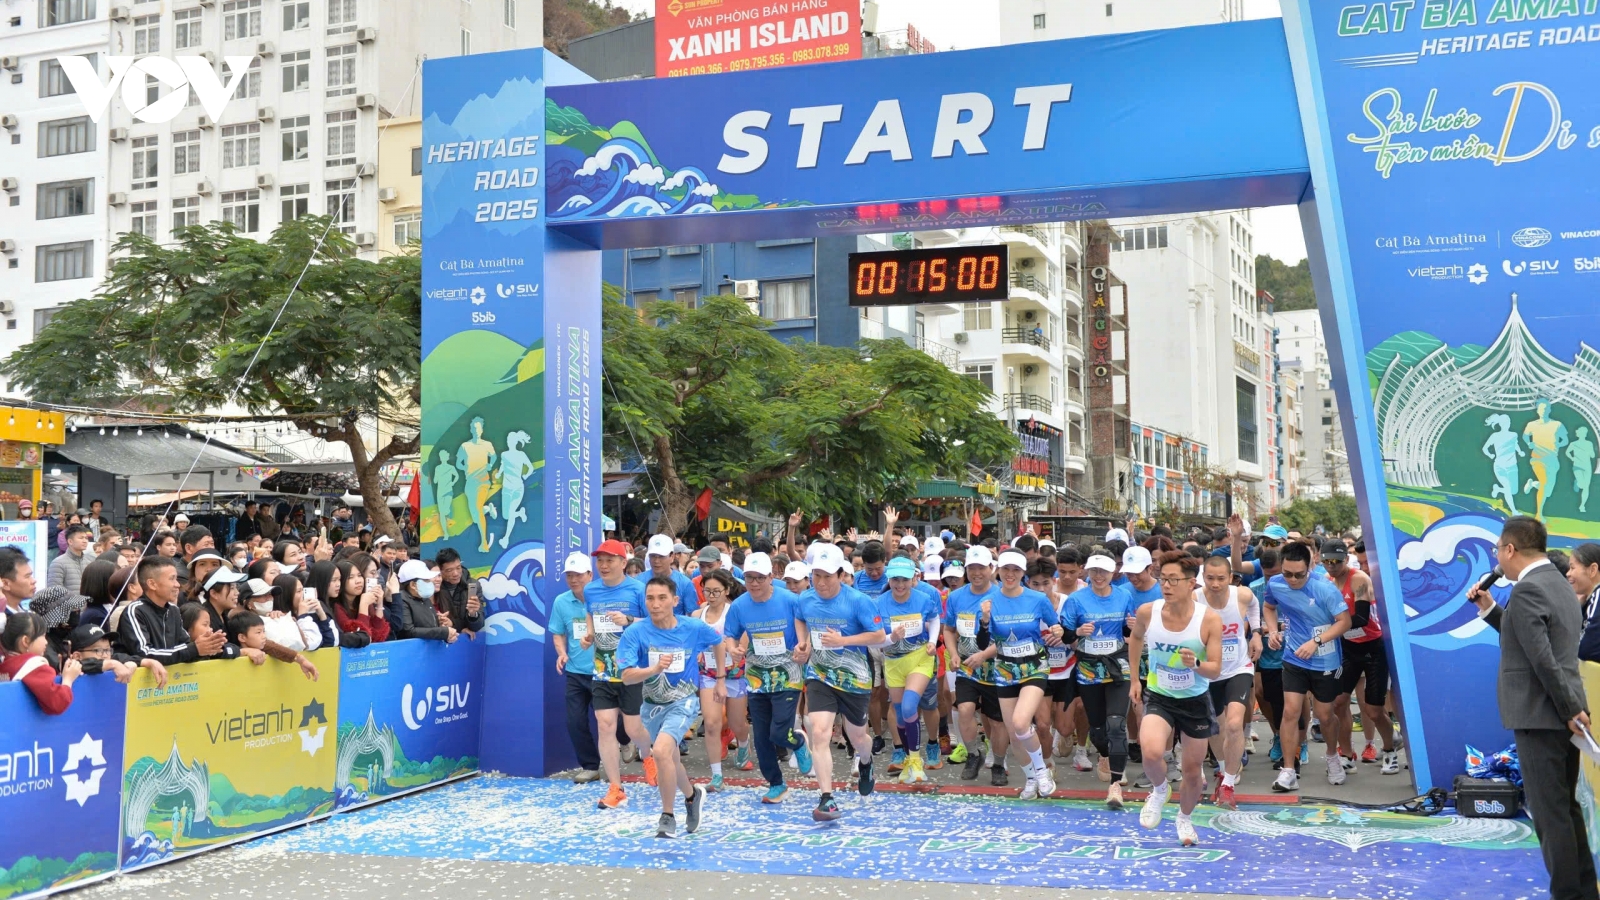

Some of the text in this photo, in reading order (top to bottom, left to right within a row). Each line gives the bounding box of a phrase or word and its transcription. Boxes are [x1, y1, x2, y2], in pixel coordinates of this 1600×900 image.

[687, 16, 713, 29] VĂN
[716, 8, 760, 25] PHÒNG
[763, 2, 788, 18] BÁN
[1338, 0, 1416, 37] CAT
[1421, 0, 1478, 30] BA
[668, 11, 849, 62] XANH ISLAND
[1420, 30, 1534, 56] HERITAGE
[730, 54, 785, 71] 0979.795.356
[793, 43, 850, 63] 0983.078.399
[716, 83, 1073, 175] START
[1491, 81, 1577, 167] Di
[427, 135, 539, 165] HERITAGE
[474, 167, 539, 192] ROAD
[475, 199, 539, 223] 2025
[1425, 232, 1487, 246] Amatina
[1407, 263, 1464, 277] vietanh
[1529, 260, 1559, 271] SIV
[426, 287, 468, 299] vietanh
[516, 283, 539, 294] SIV
[568, 326, 581, 473] AMATINA
[582, 328, 591, 526] HERITAGE ROAD 2025
[568, 479, 581, 525] BA
[1010, 645, 1031, 655] 8878
[1167, 673, 1190, 681] 8891
[435, 681, 471, 712] SIV
[206, 703, 293, 744] vietanh
[244, 733, 293, 750] PRODUCTION
